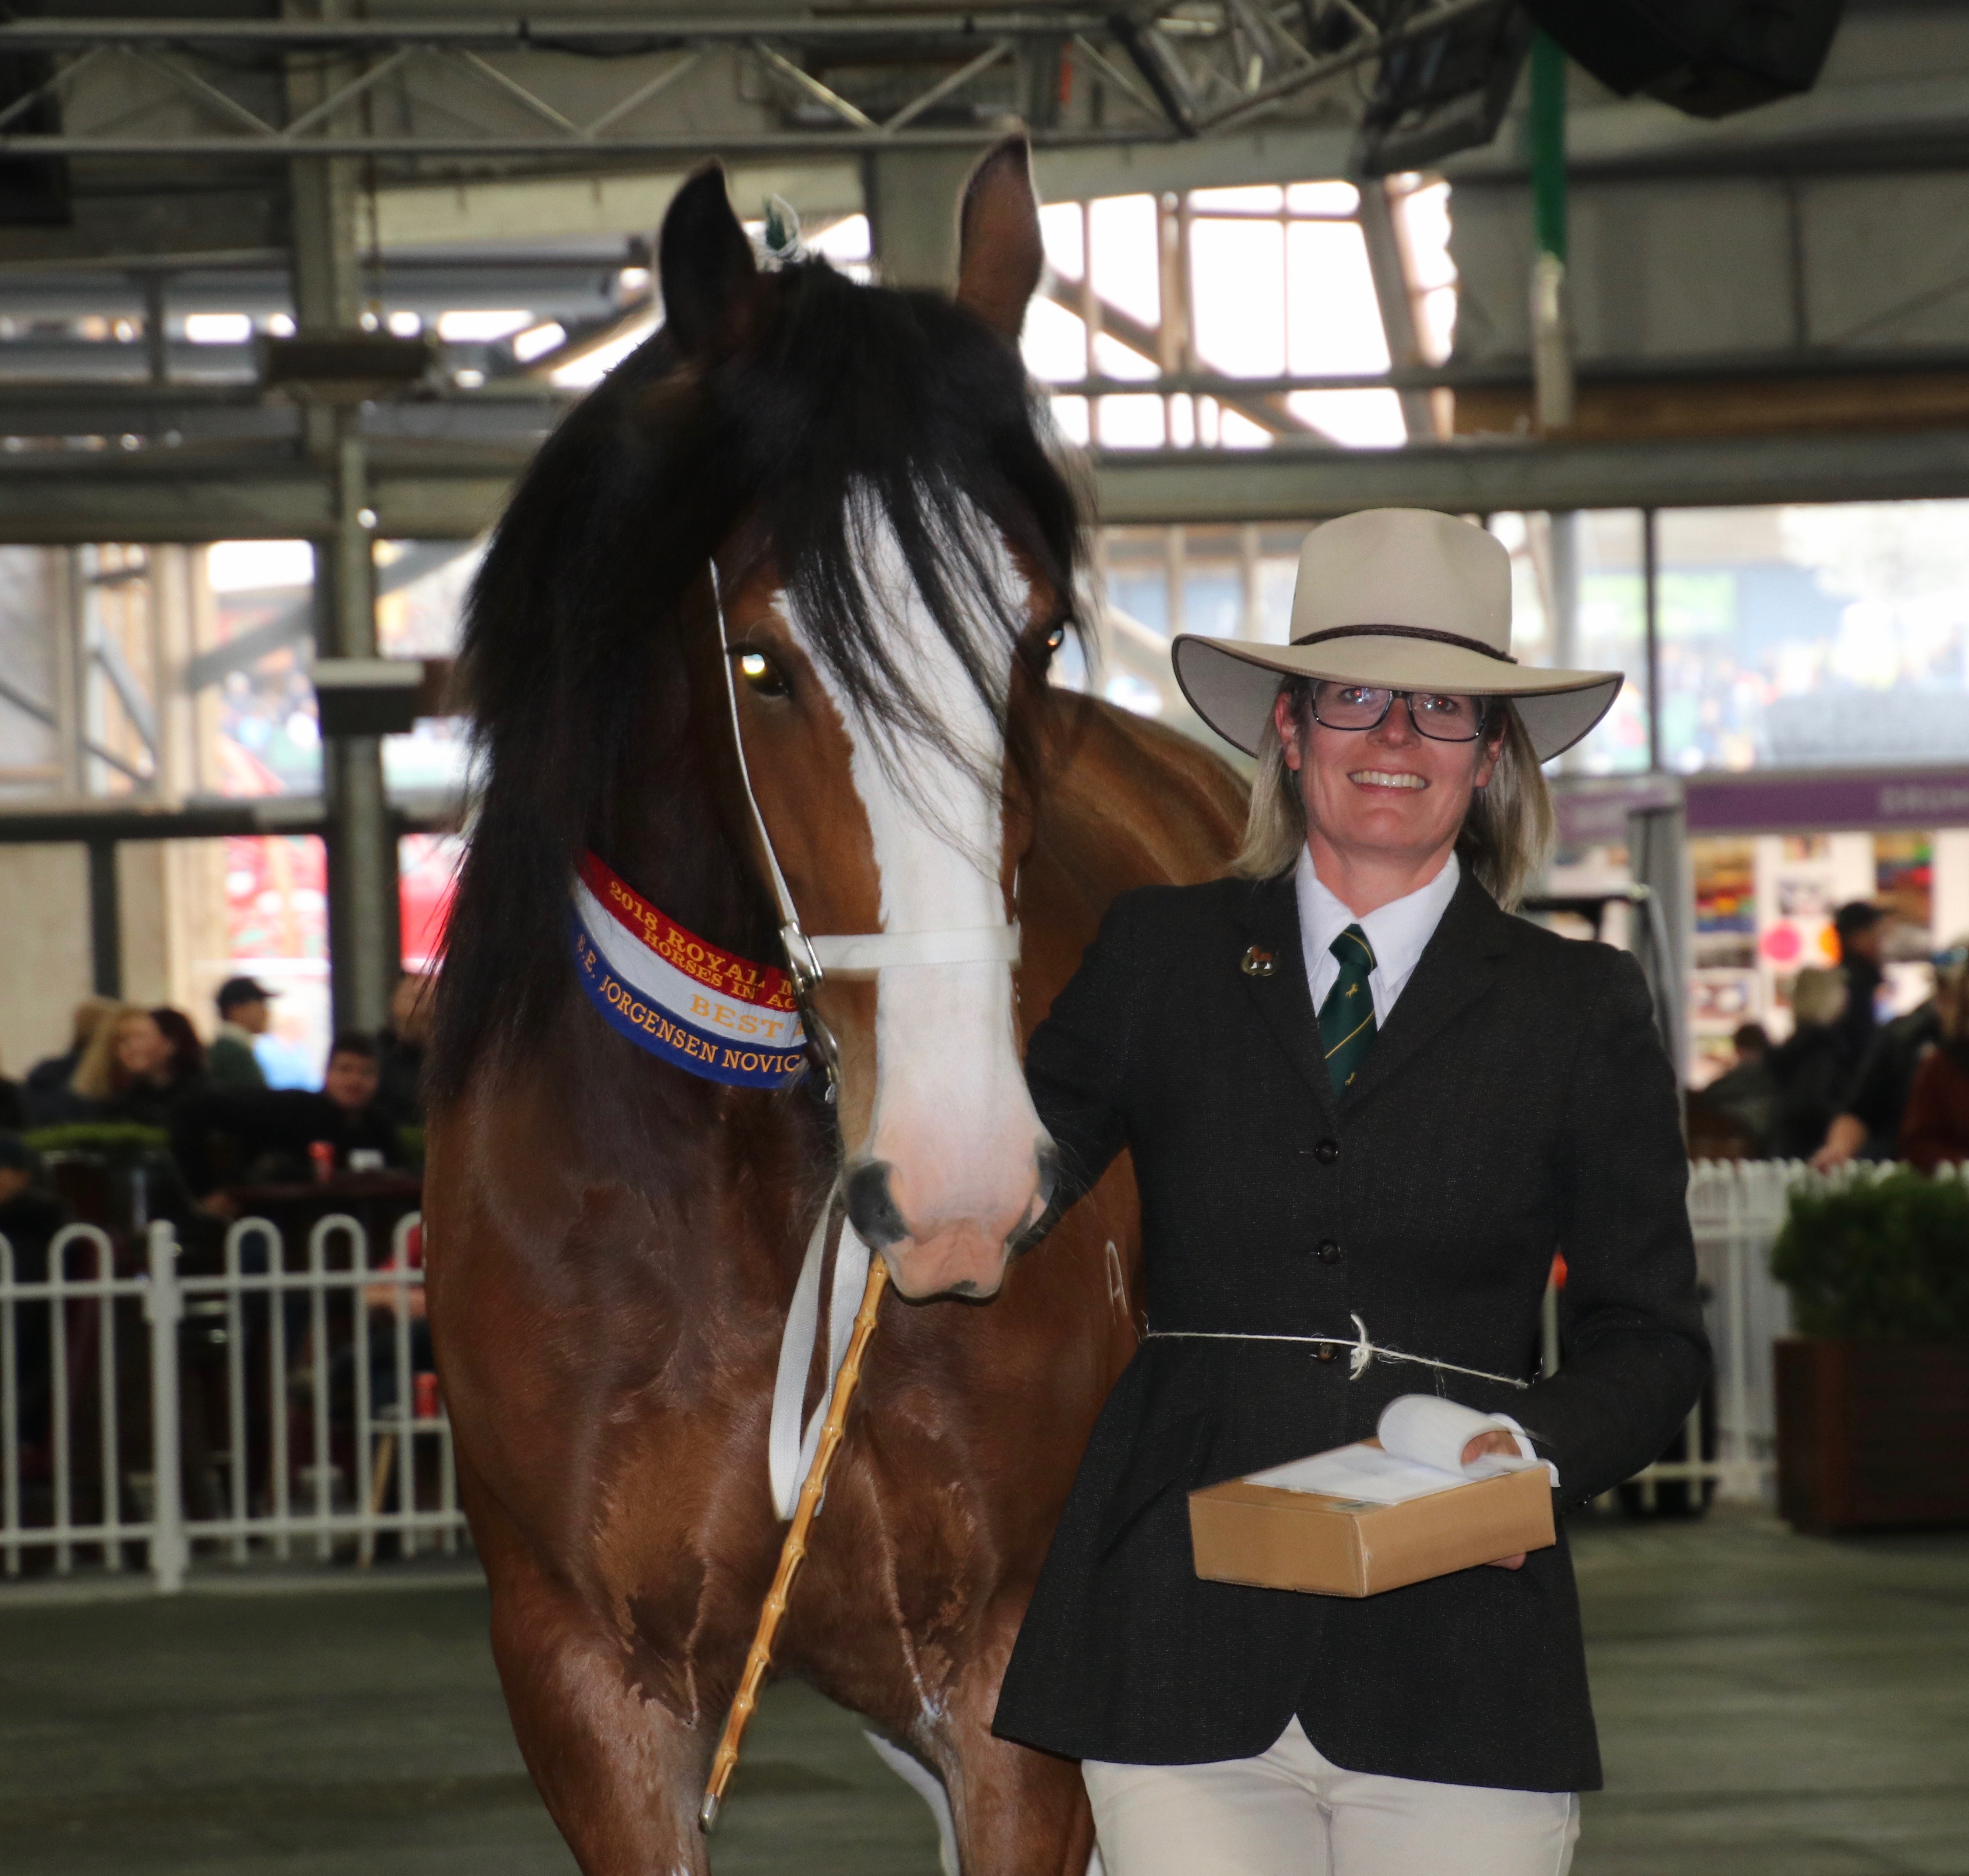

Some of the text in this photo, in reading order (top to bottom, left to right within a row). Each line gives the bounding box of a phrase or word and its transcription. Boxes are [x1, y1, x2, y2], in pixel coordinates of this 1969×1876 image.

[609, 881, 658, 931] 2018
[666, 927, 765, 989] ROYAL
[643, 927, 723, 987] HORSES
[731, 981, 755, 1000] IN
[598, 974, 719, 1063] JORGENSEN
[690, 993, 784, 1038] BEST
